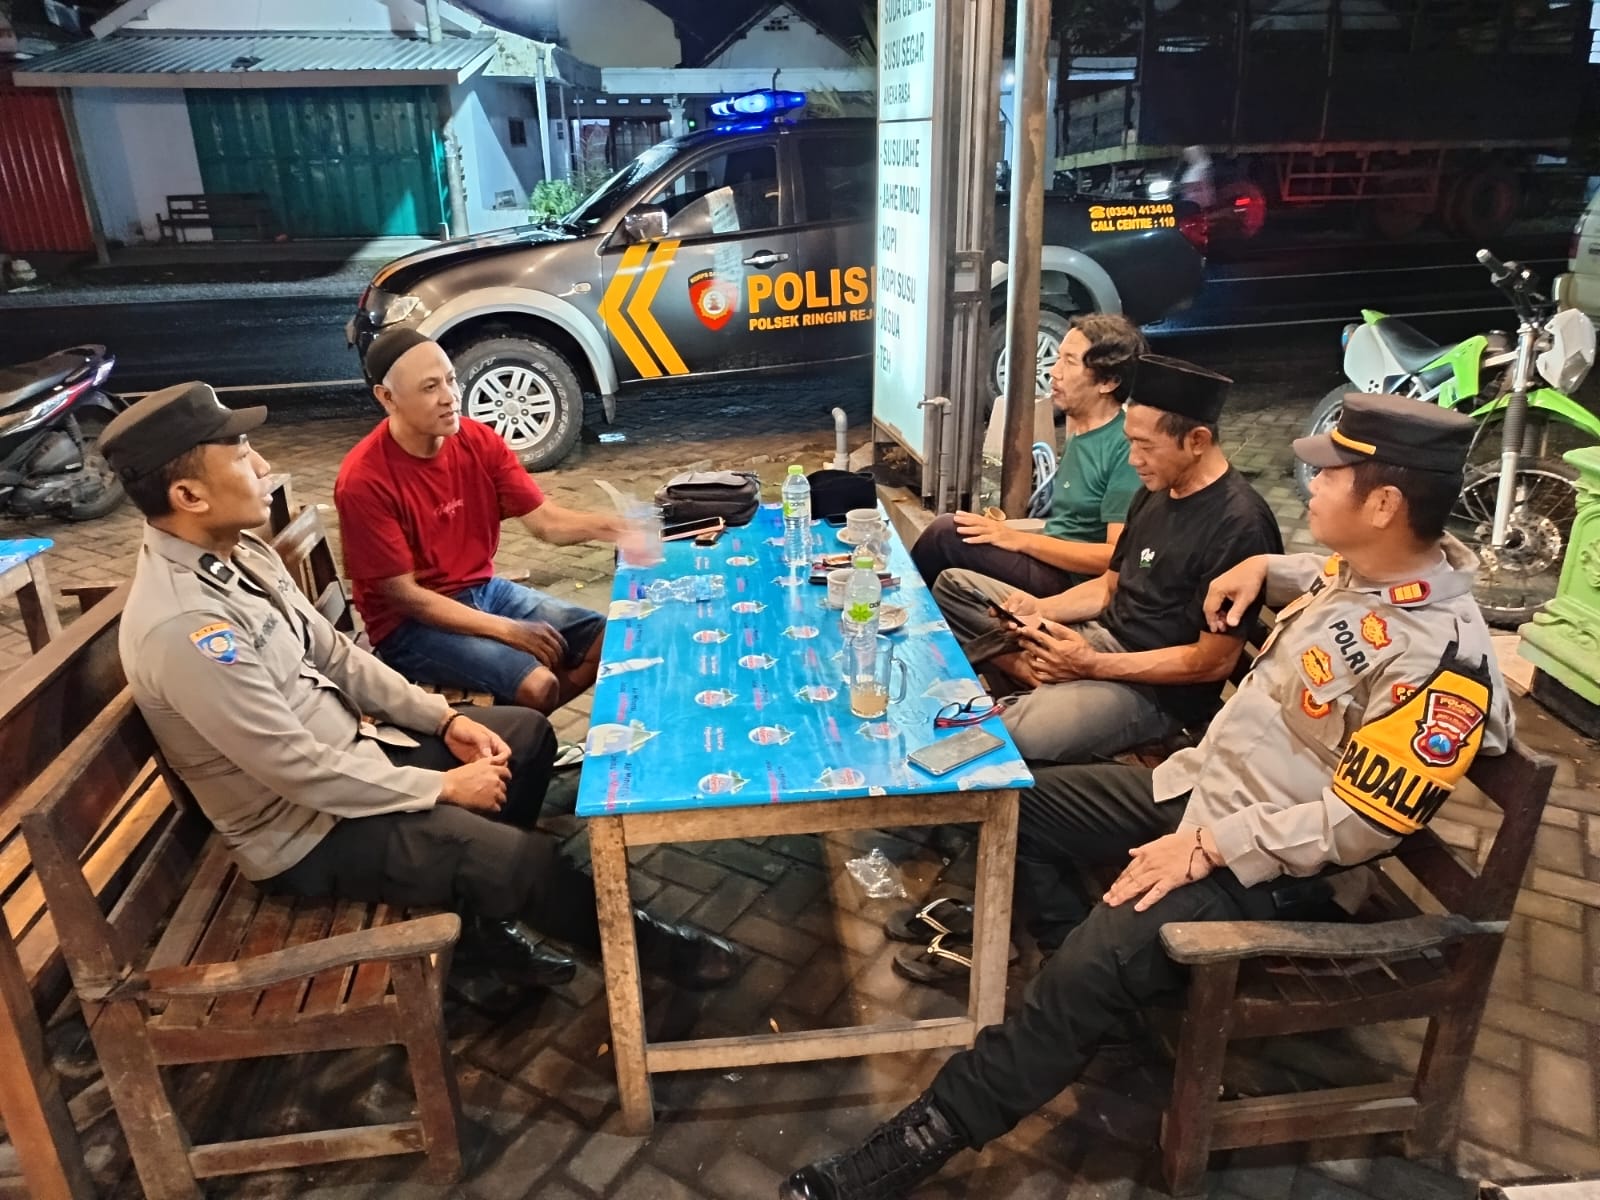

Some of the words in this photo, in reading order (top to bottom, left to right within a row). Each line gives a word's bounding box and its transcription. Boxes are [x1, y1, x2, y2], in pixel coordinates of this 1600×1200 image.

[884, 40, 901, 70] SUSU
[902, 32, 925, 67] SEGAR
[883, 138, 901, 167] SUSU
[902, 138, 919, 168] JAHE
[882, 184, 898, 211] JAHE
[900, 185, 920, 215] MADU
[882, 224, 897, 254] KOPI
[1091, 219, 1116, 232] CALL
[1159, 216, 1175, 228] 110
[881, 266, 896, 296] KOPI
[897, 272, 916, 305] SUSU
[749, 315, 800, 331] POLSEK
[802, 310, 847, 327] RINGIN
[850, 308, 875, 322] REJ
[880, 345, 891, 374] TEH
[1328, 619, 1370, 675] POLRI
